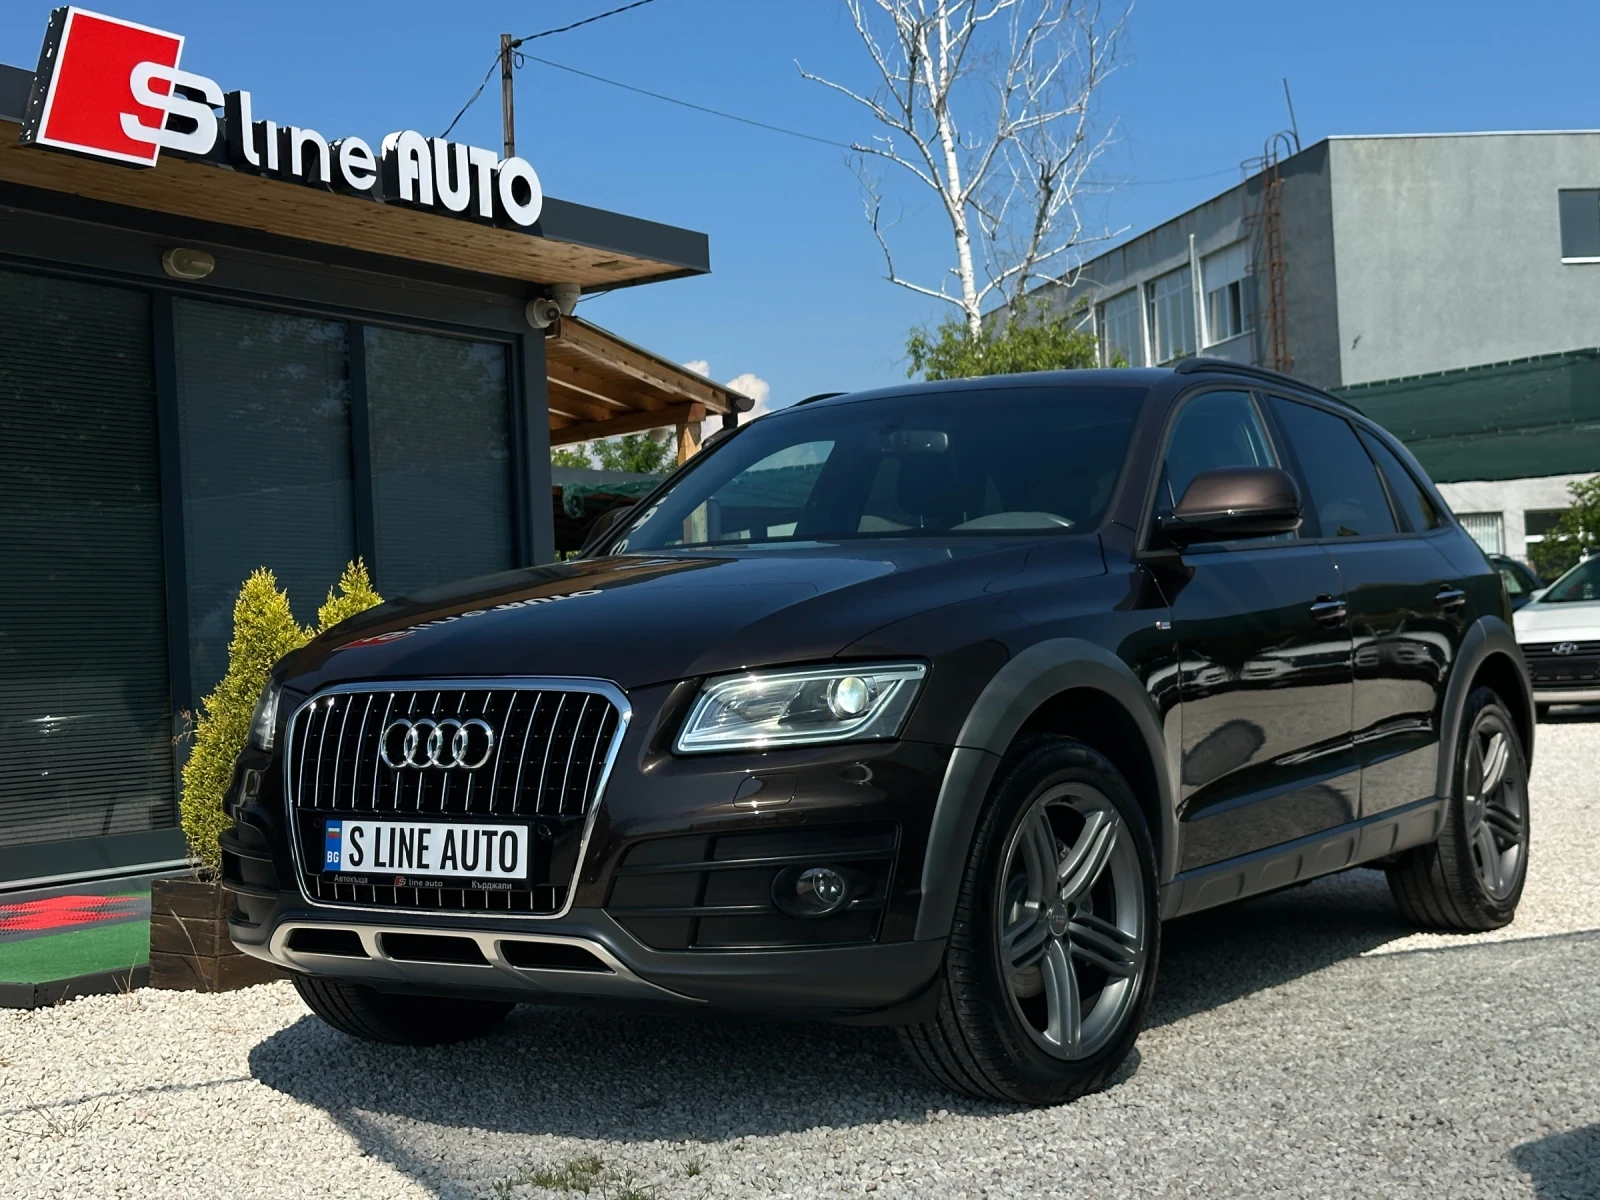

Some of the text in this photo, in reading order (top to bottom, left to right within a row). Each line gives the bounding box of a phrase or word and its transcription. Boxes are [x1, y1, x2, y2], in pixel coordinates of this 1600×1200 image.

[119, 60, 543, 227] S line AUTO
[348, 825, 519, 873] S LINE AUTO
[326, 850, 340, 864] BG
[333, 873, 369, 885] Автокъща
[408, 877, 424, 887] line
[424, 879, 444, 888] auto
[471, 880, 513, 891] Кърджали
